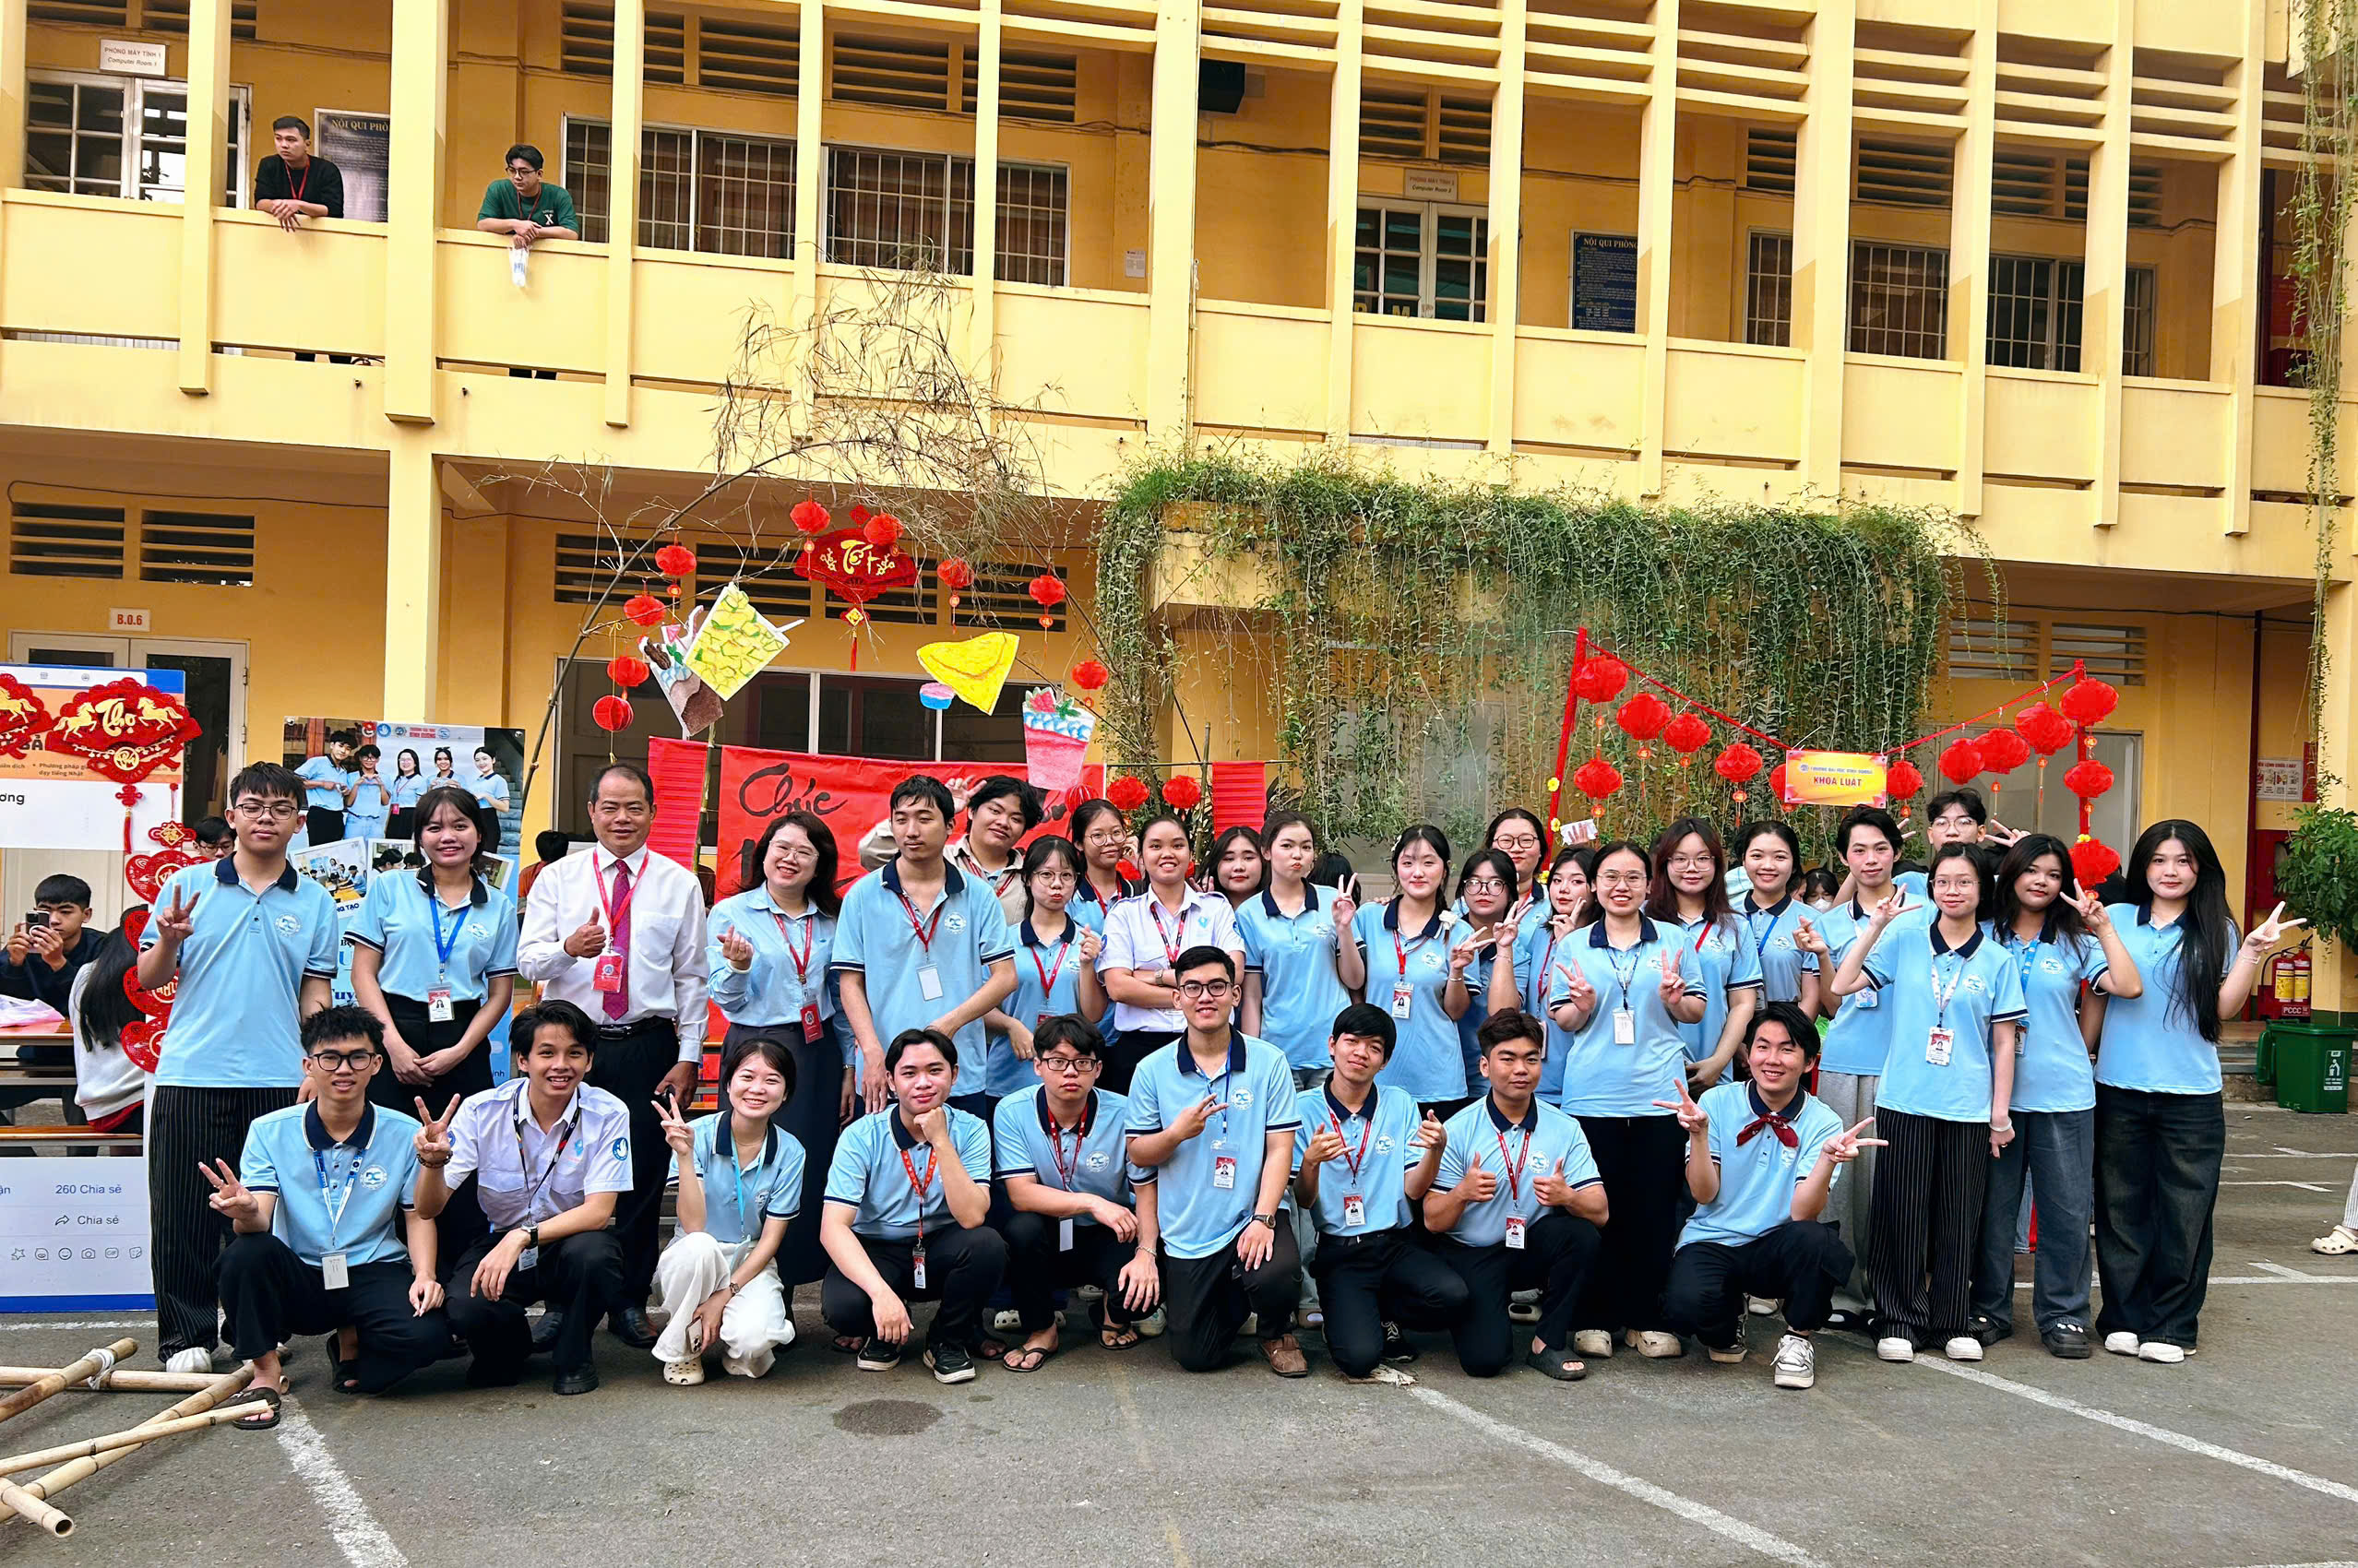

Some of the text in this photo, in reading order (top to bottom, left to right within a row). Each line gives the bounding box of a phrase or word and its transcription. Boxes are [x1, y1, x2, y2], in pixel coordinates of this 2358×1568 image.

[369, 123, 388, 132] PHÒ
[544, 214, 554, 225] X
[95, 697, 137, 737] Thọ
[1814, 777, 1837, 785] KHOA
[2283, 1006, 2302, 1015] PCCC
[55, 1184, 77, 1194] 260
[79, 1184, 105, 1194] Chia
[77, 1215, 120, 1225] Chia sẻ
